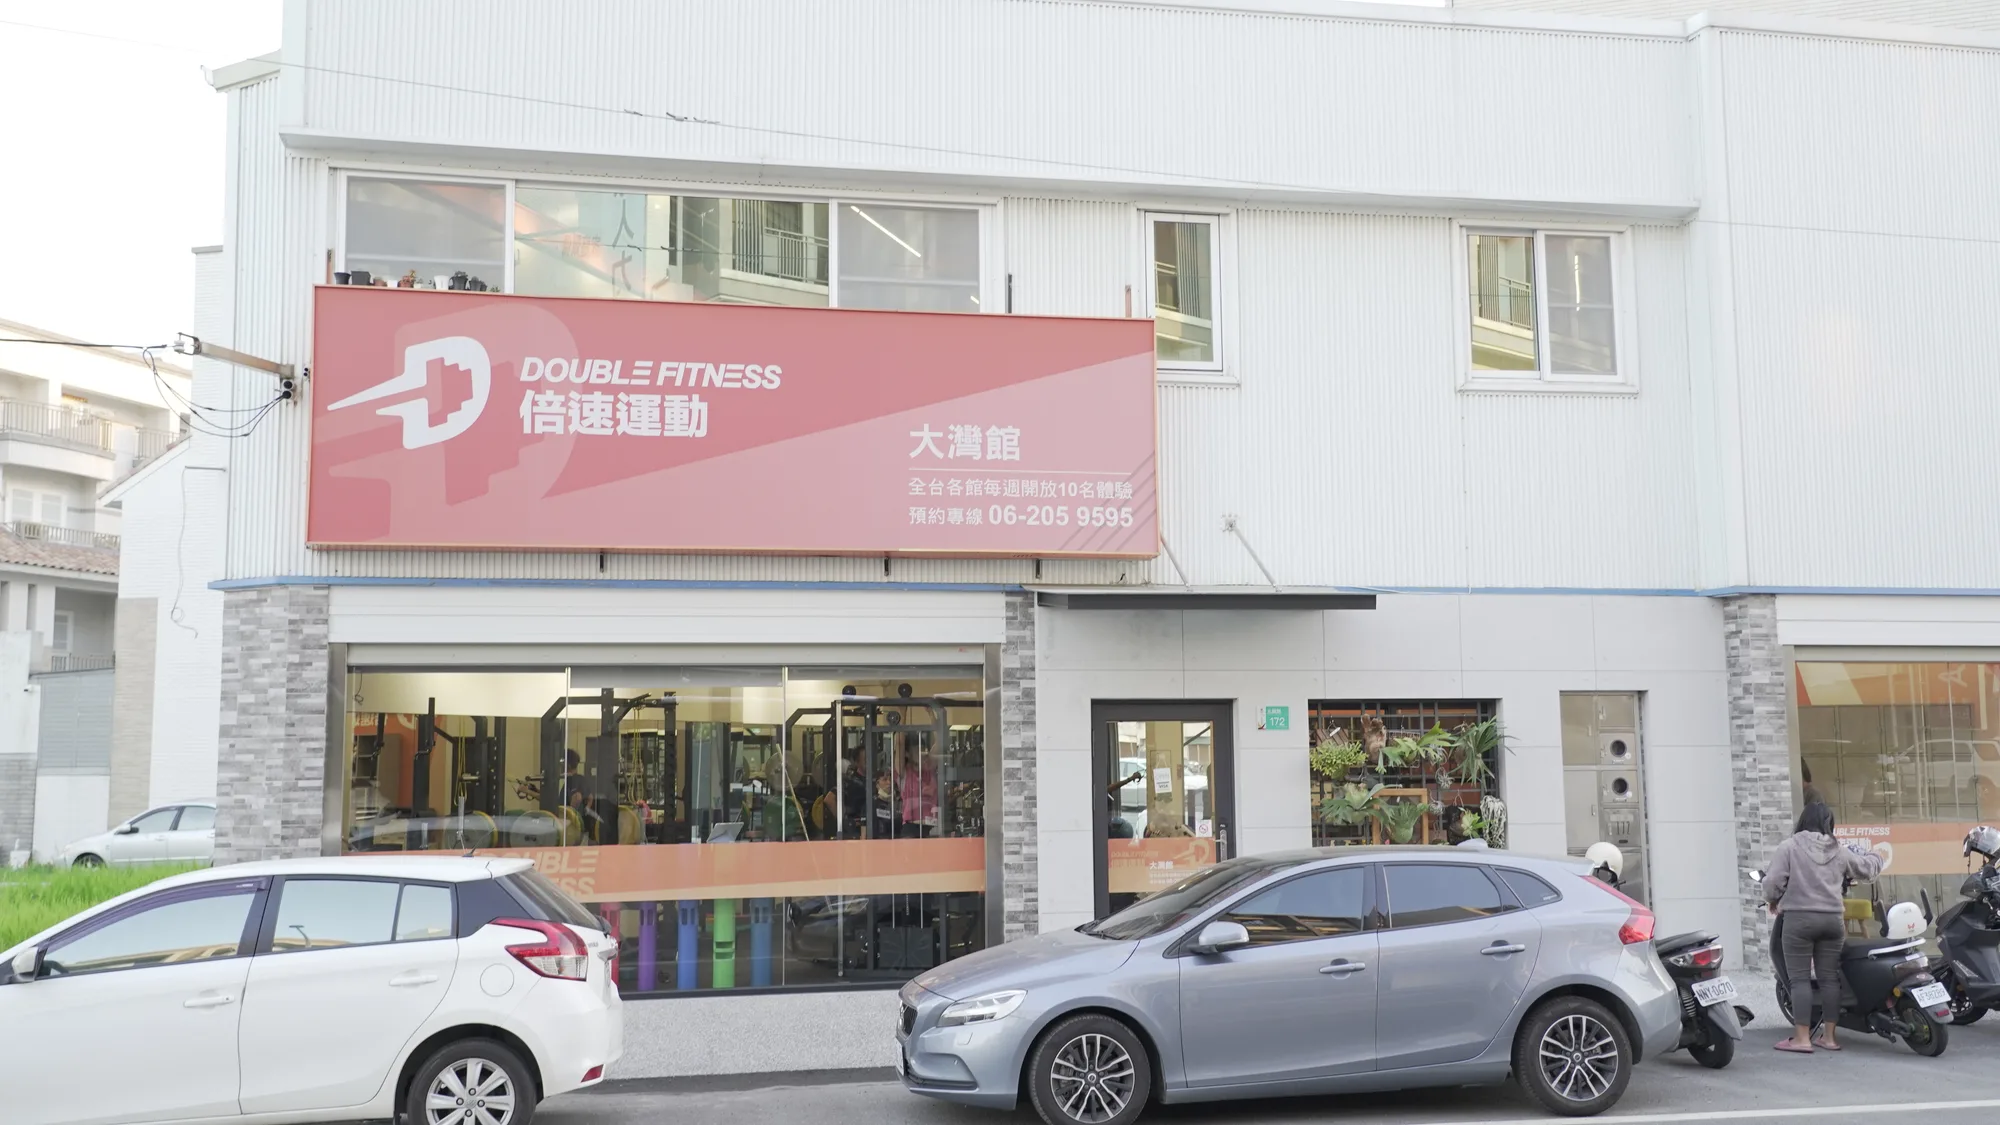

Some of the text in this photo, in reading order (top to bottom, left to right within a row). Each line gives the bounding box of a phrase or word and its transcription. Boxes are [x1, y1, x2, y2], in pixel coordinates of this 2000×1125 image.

[520, 357, 782, 390] DOUBLE FITNESS
[520, 389, 708, 438] 倍速運動
[909, 423, 1021, 461] 大灣館
[908, 477, 1133, 500] 全台各館每週開放10名體驗
[909, 504, 1134, 528] 預約專線 06-205 9595
[1269, 716, 1285, 726] 172
[1856, 827, 1890, 836] FITNESS
